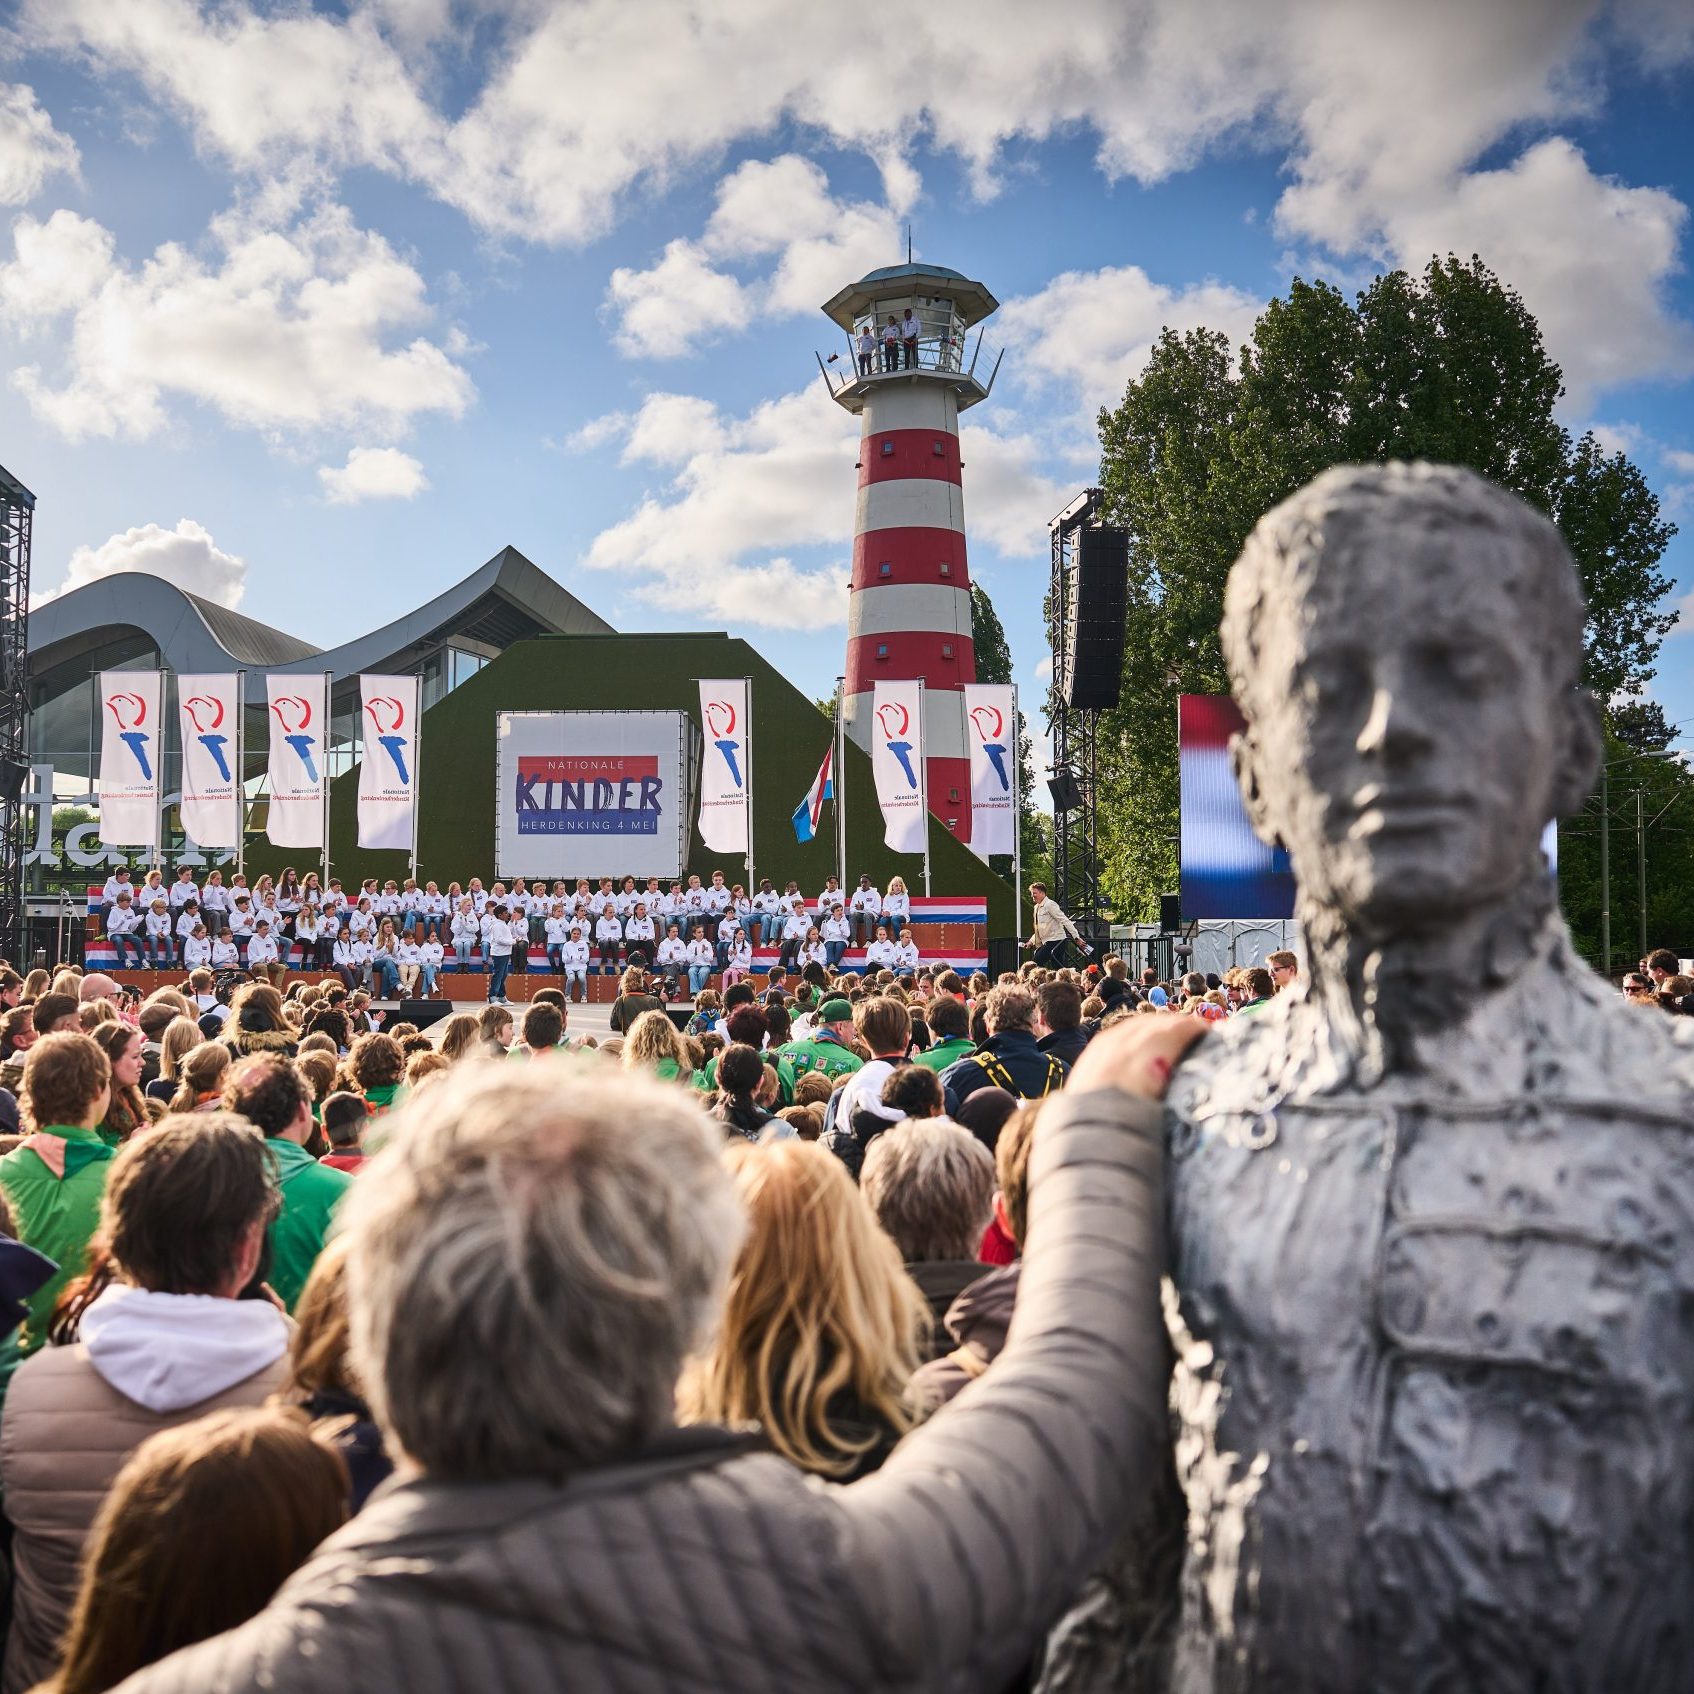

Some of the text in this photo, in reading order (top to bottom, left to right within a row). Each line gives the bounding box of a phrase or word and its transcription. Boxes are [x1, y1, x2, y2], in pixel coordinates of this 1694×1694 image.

[548, 760, 625, 771] NATIONALE
[515, 772, 664, 816] KINDER
[521, 820, 656, 831] HERDENKING 4 MEI
